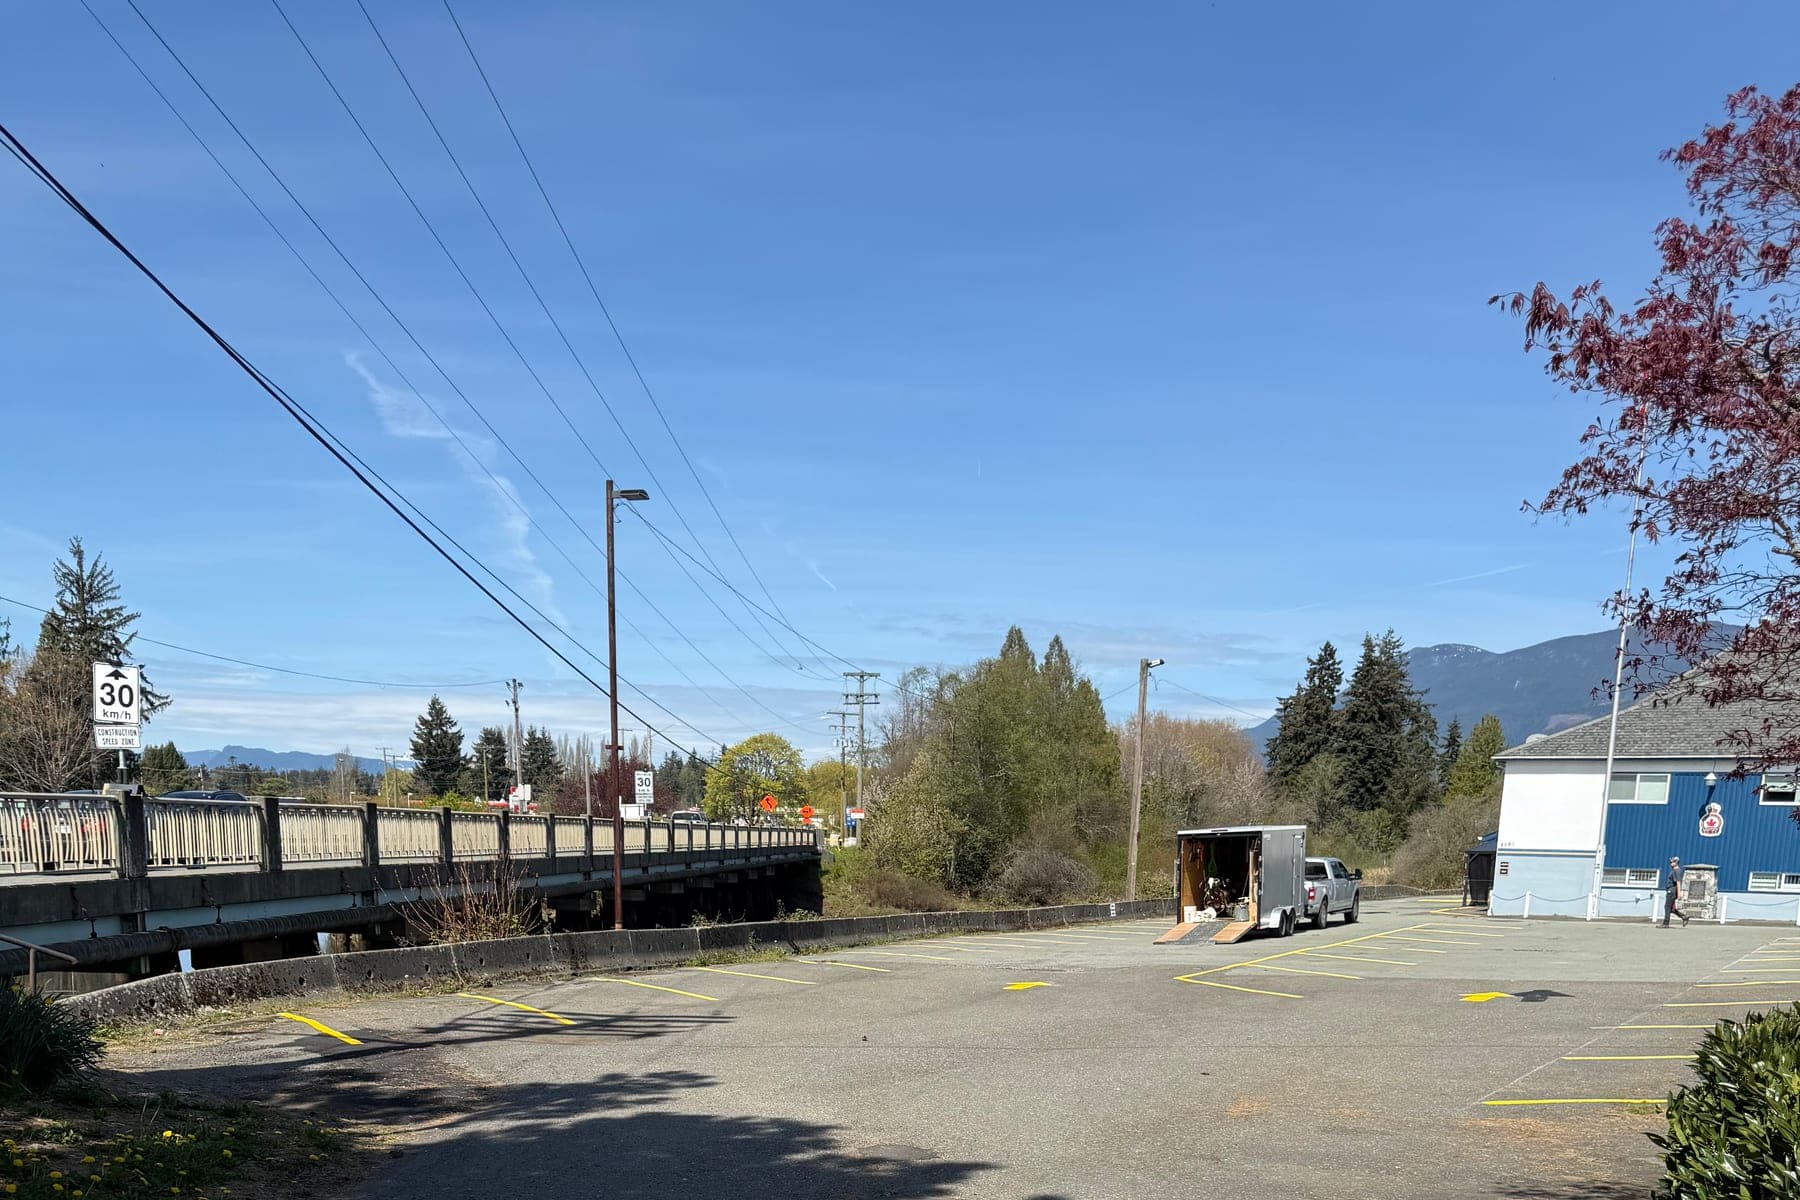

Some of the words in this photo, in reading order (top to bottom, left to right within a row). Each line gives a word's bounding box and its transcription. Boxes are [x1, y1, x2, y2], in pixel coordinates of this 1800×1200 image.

[100, 682, 134, 708] 30
[102, 709, 132, 720] km/h
[97, 728, 137, 737] CONSTRUCTION
[101, 737, 119, 746] SPEED
[121, 738, 135, 746] ZONE
[637, 777, 651, 787] 30
